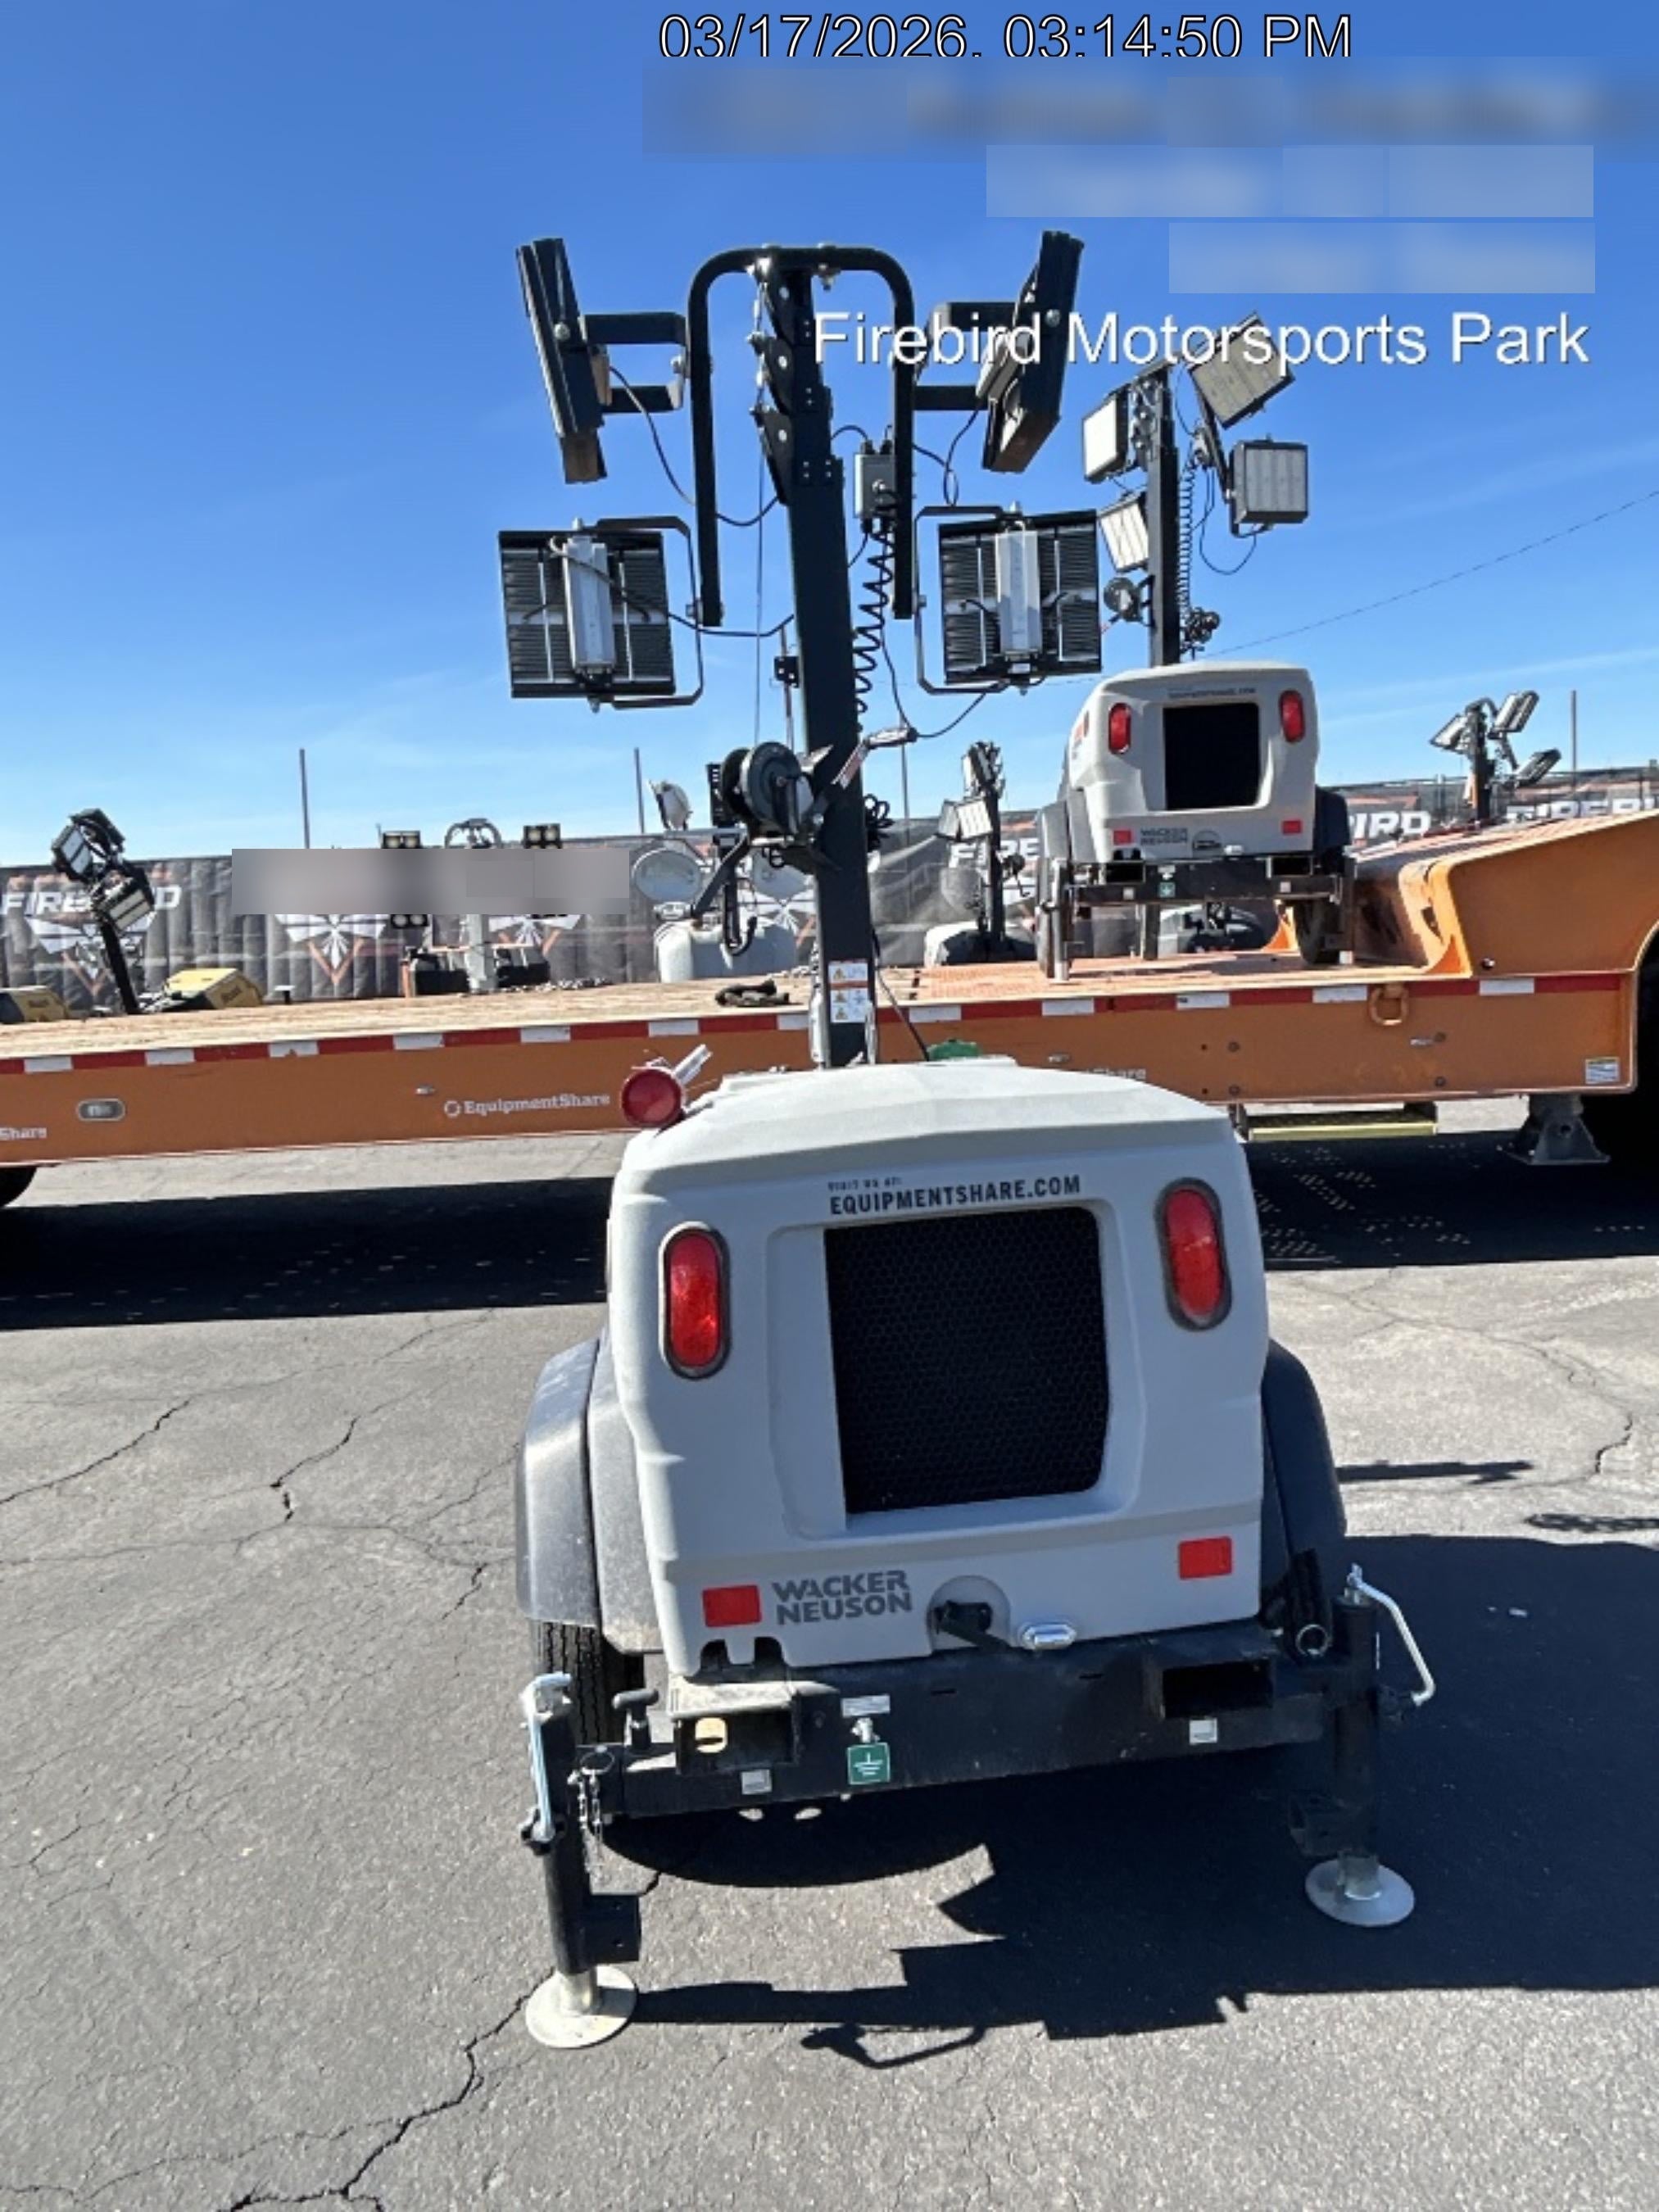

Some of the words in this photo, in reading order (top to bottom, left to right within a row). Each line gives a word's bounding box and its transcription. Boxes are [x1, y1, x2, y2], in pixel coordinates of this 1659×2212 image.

[1349, 810, 1431, 838] IRD
[463, 1093, 610, 1116] EquipmentShare
[830, 1174, 1081, 1215] EQUIPMENTSHARE.COM
[772, 1570, 910, 1602] WACKER
[777, 1592, 913, 1625] NEUSON
